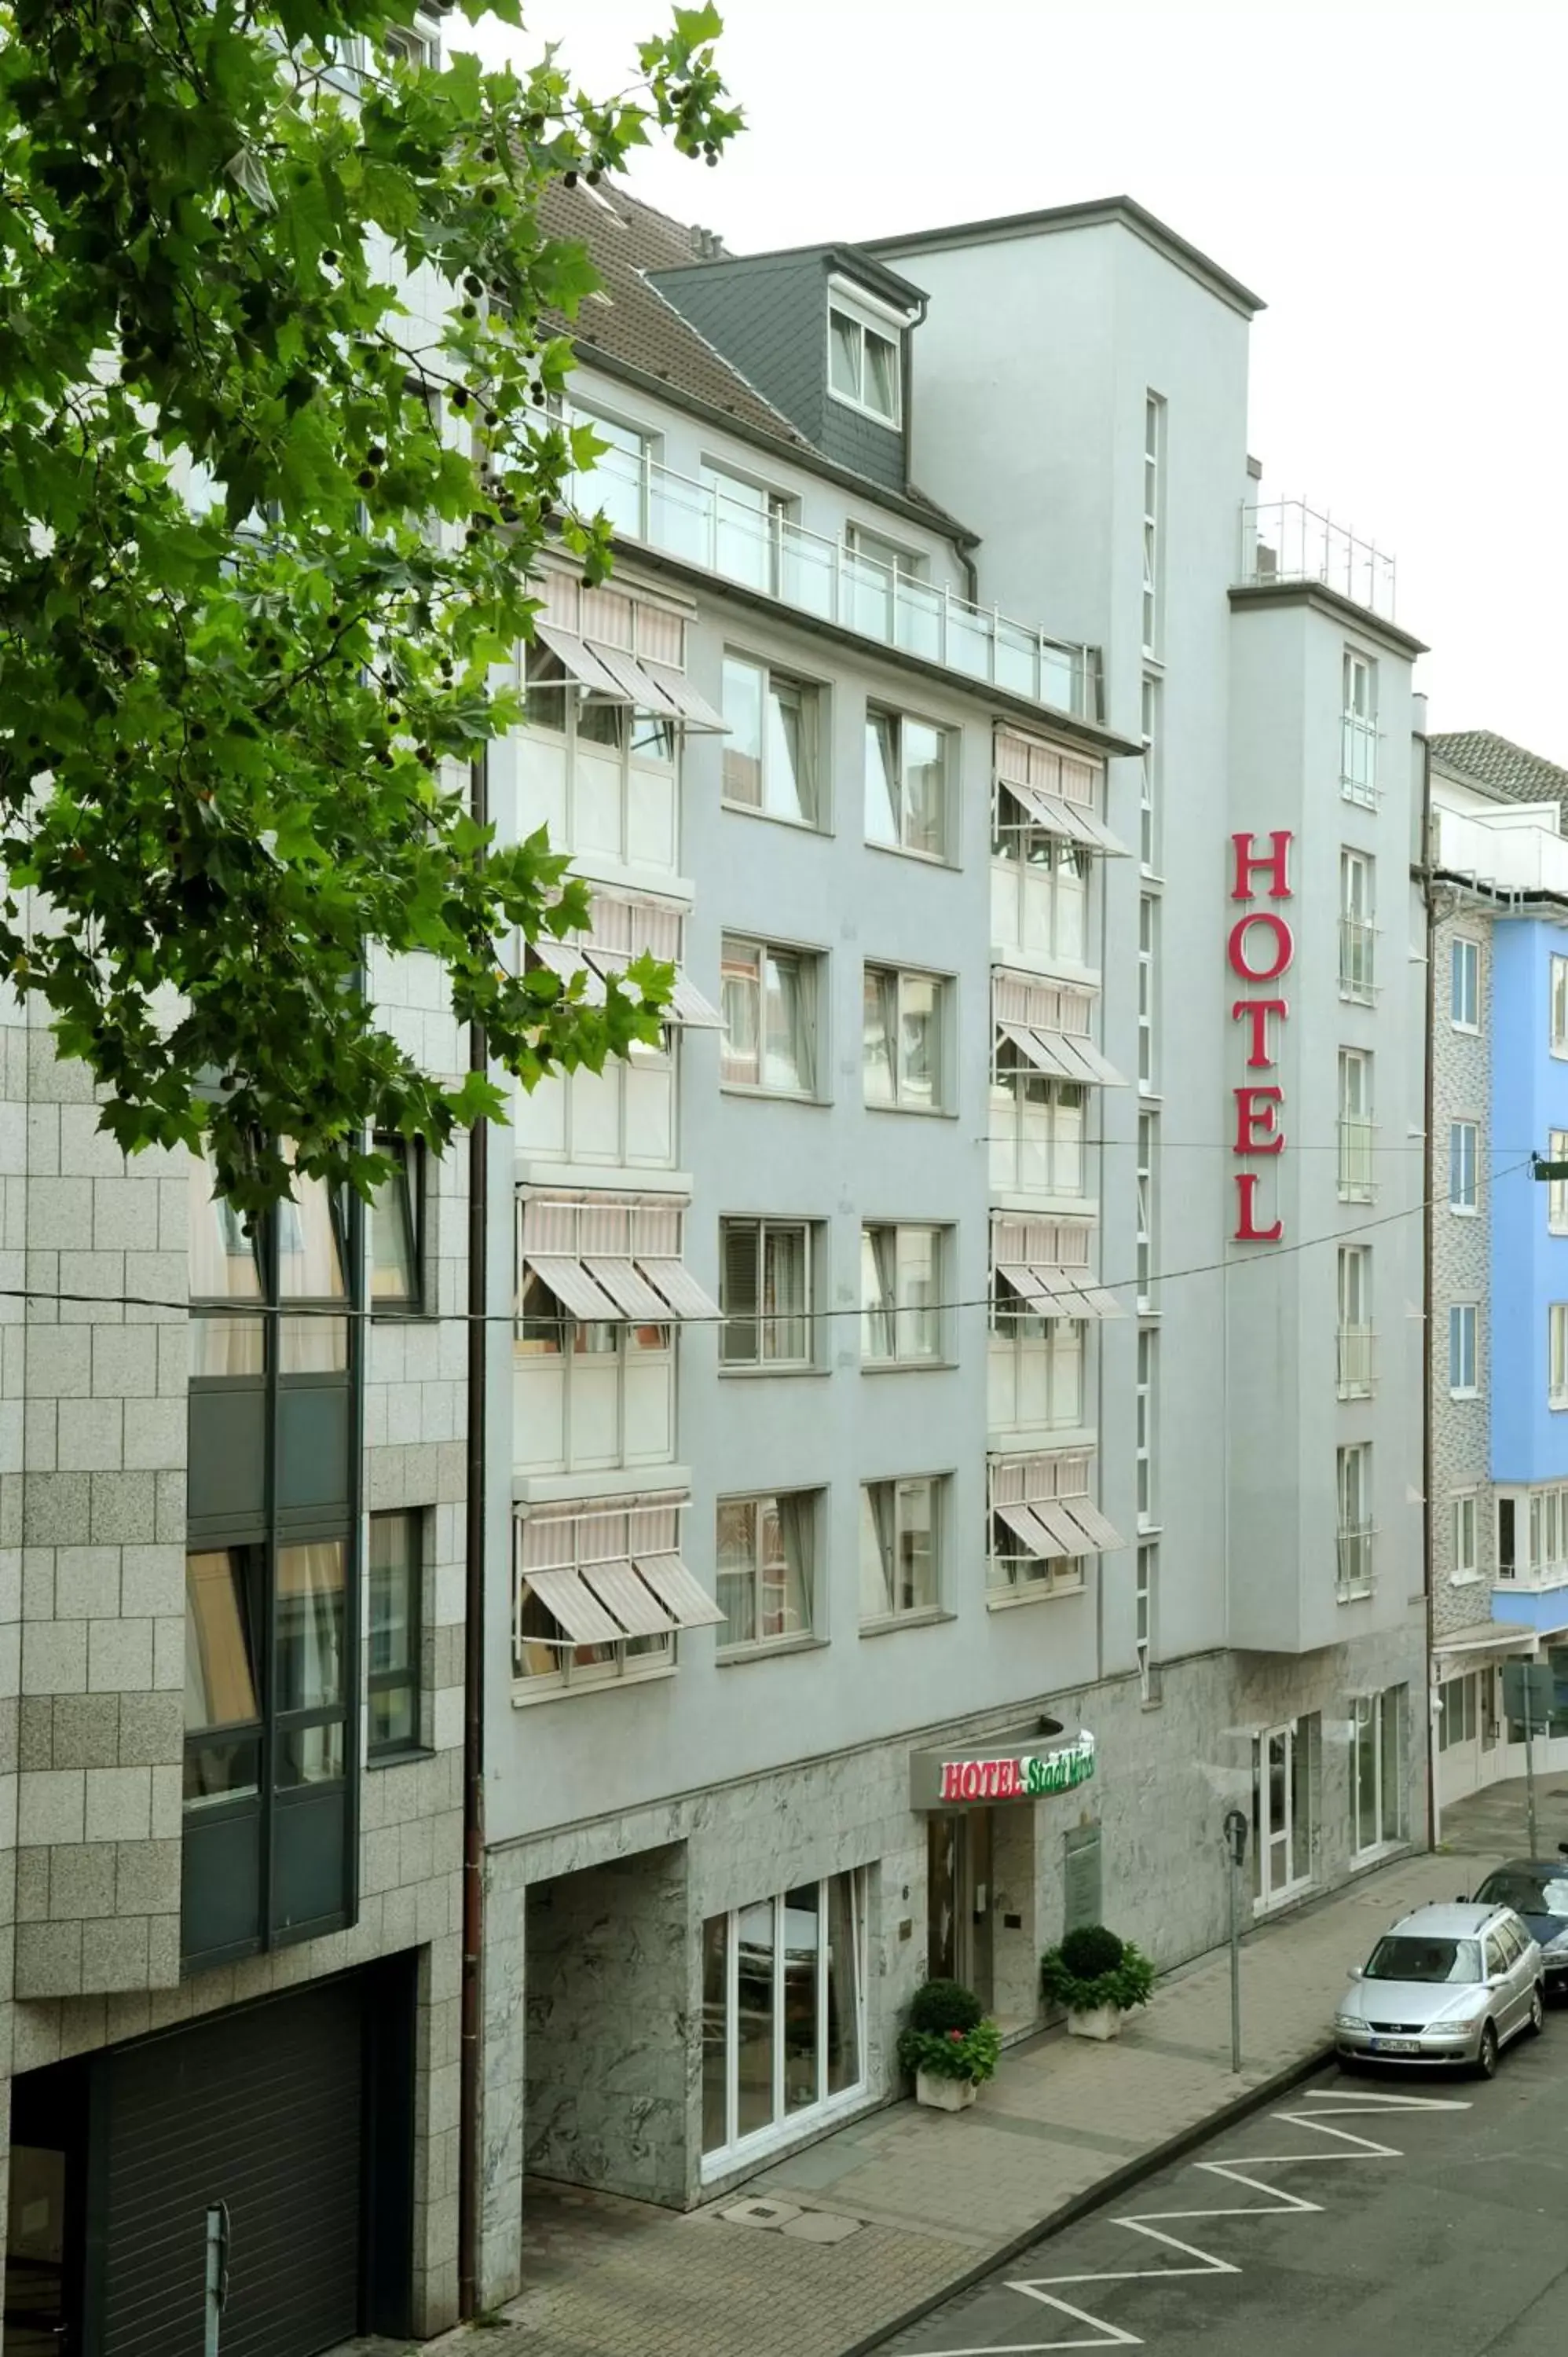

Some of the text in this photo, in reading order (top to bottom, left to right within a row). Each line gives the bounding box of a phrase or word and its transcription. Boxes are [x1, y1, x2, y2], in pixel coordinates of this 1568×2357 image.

[1228, 830, 1294, 1241] HOTEL
[940, 1760, 1024, 1802] HOTEL
[1025, 1753, 1068, 1795] Stadt
